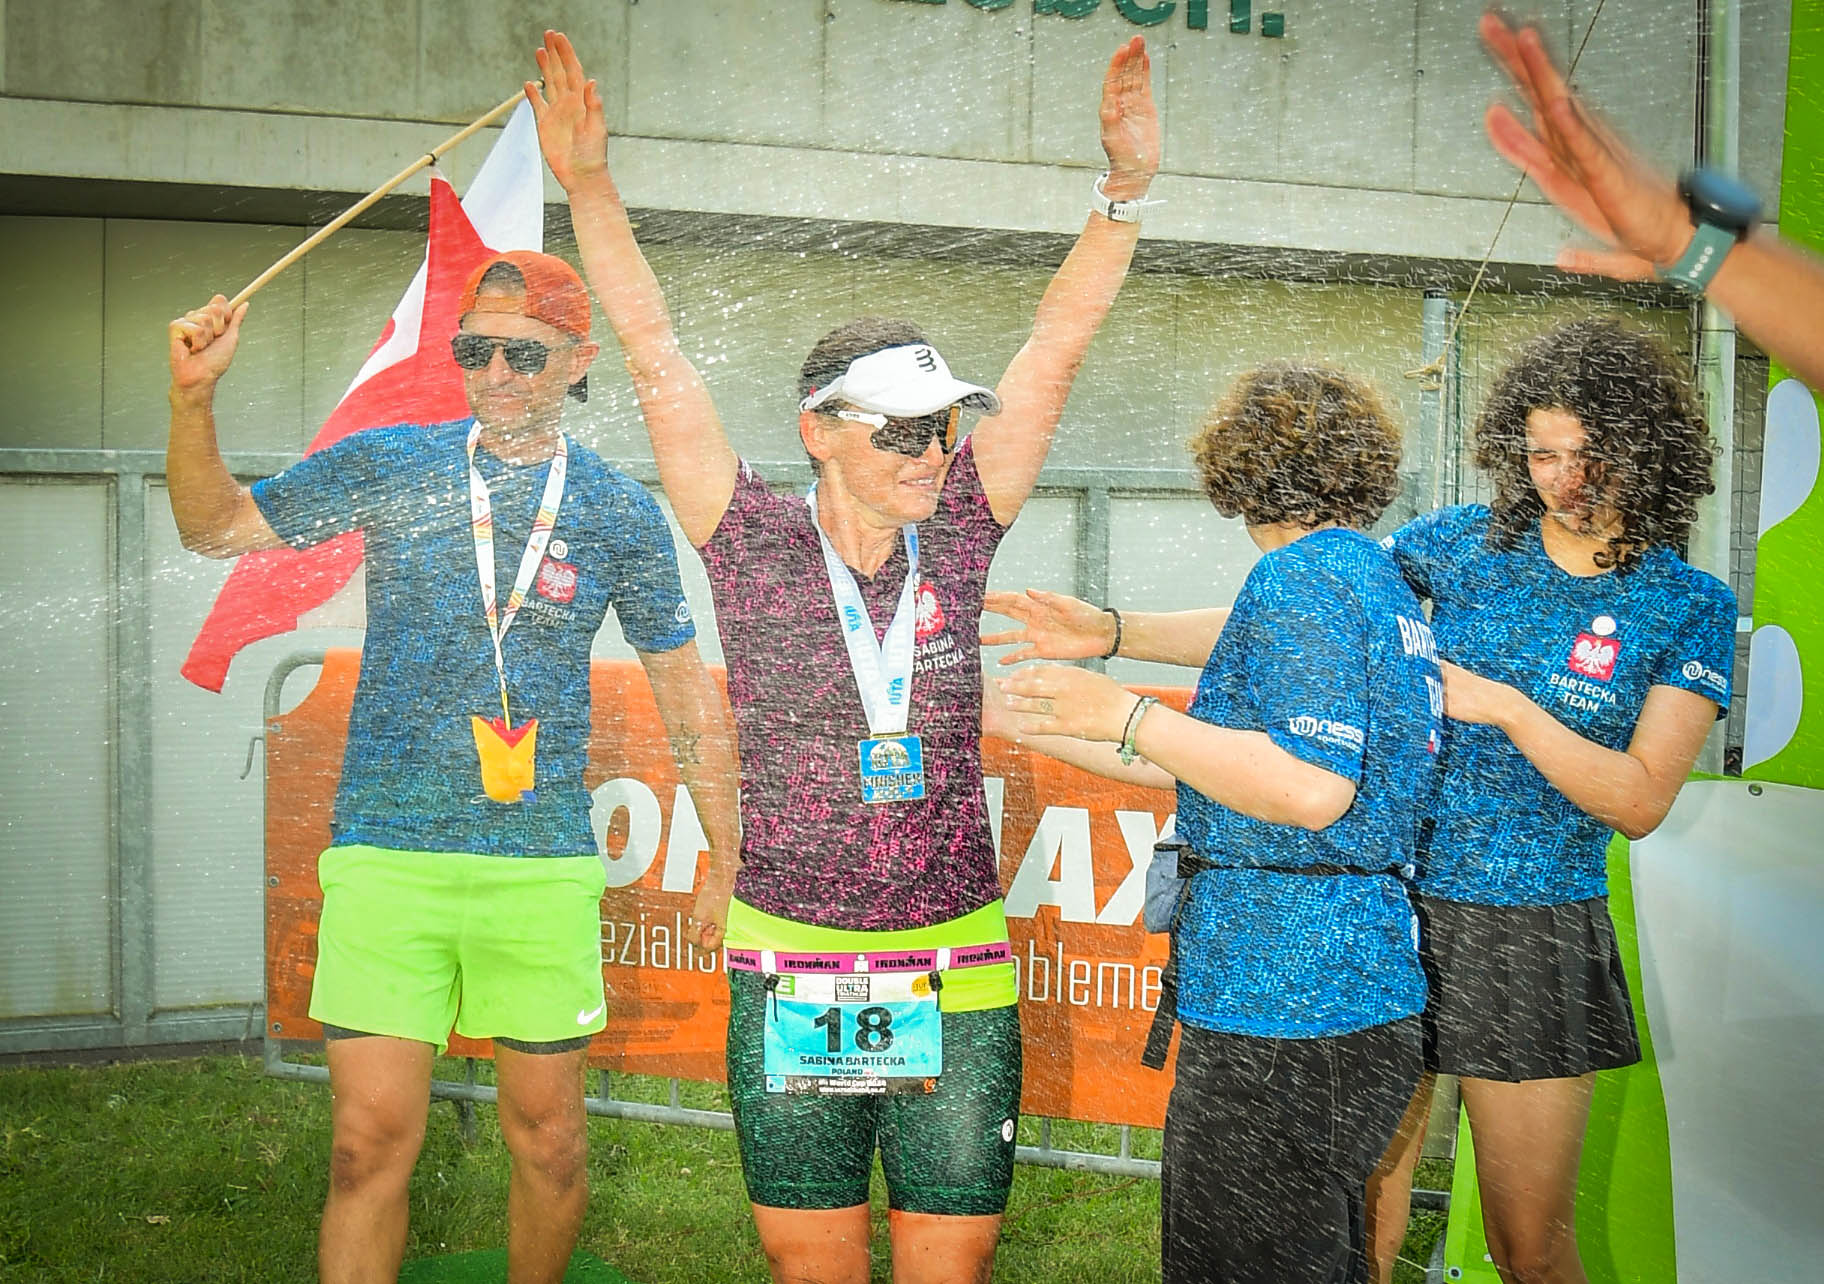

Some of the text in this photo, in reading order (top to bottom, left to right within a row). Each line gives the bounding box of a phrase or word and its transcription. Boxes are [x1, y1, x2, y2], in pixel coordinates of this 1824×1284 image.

[912, 649, 966, 673] ARTECKA
[1550, 673, 1616, 705] BARTECKA
[1563, 691, 1600, 713] TEAM
[784, 957, 840, 969] IRONMAN
[875, 955, 932, 969] IRONMAN
[836, 977, 869, 985] DOUBLE
[836, 984, 869, 993] ULTRA
[814, 1006, 895, 1053] 18
[800, 1056, 906, 1066] SABINA BARTECKA
